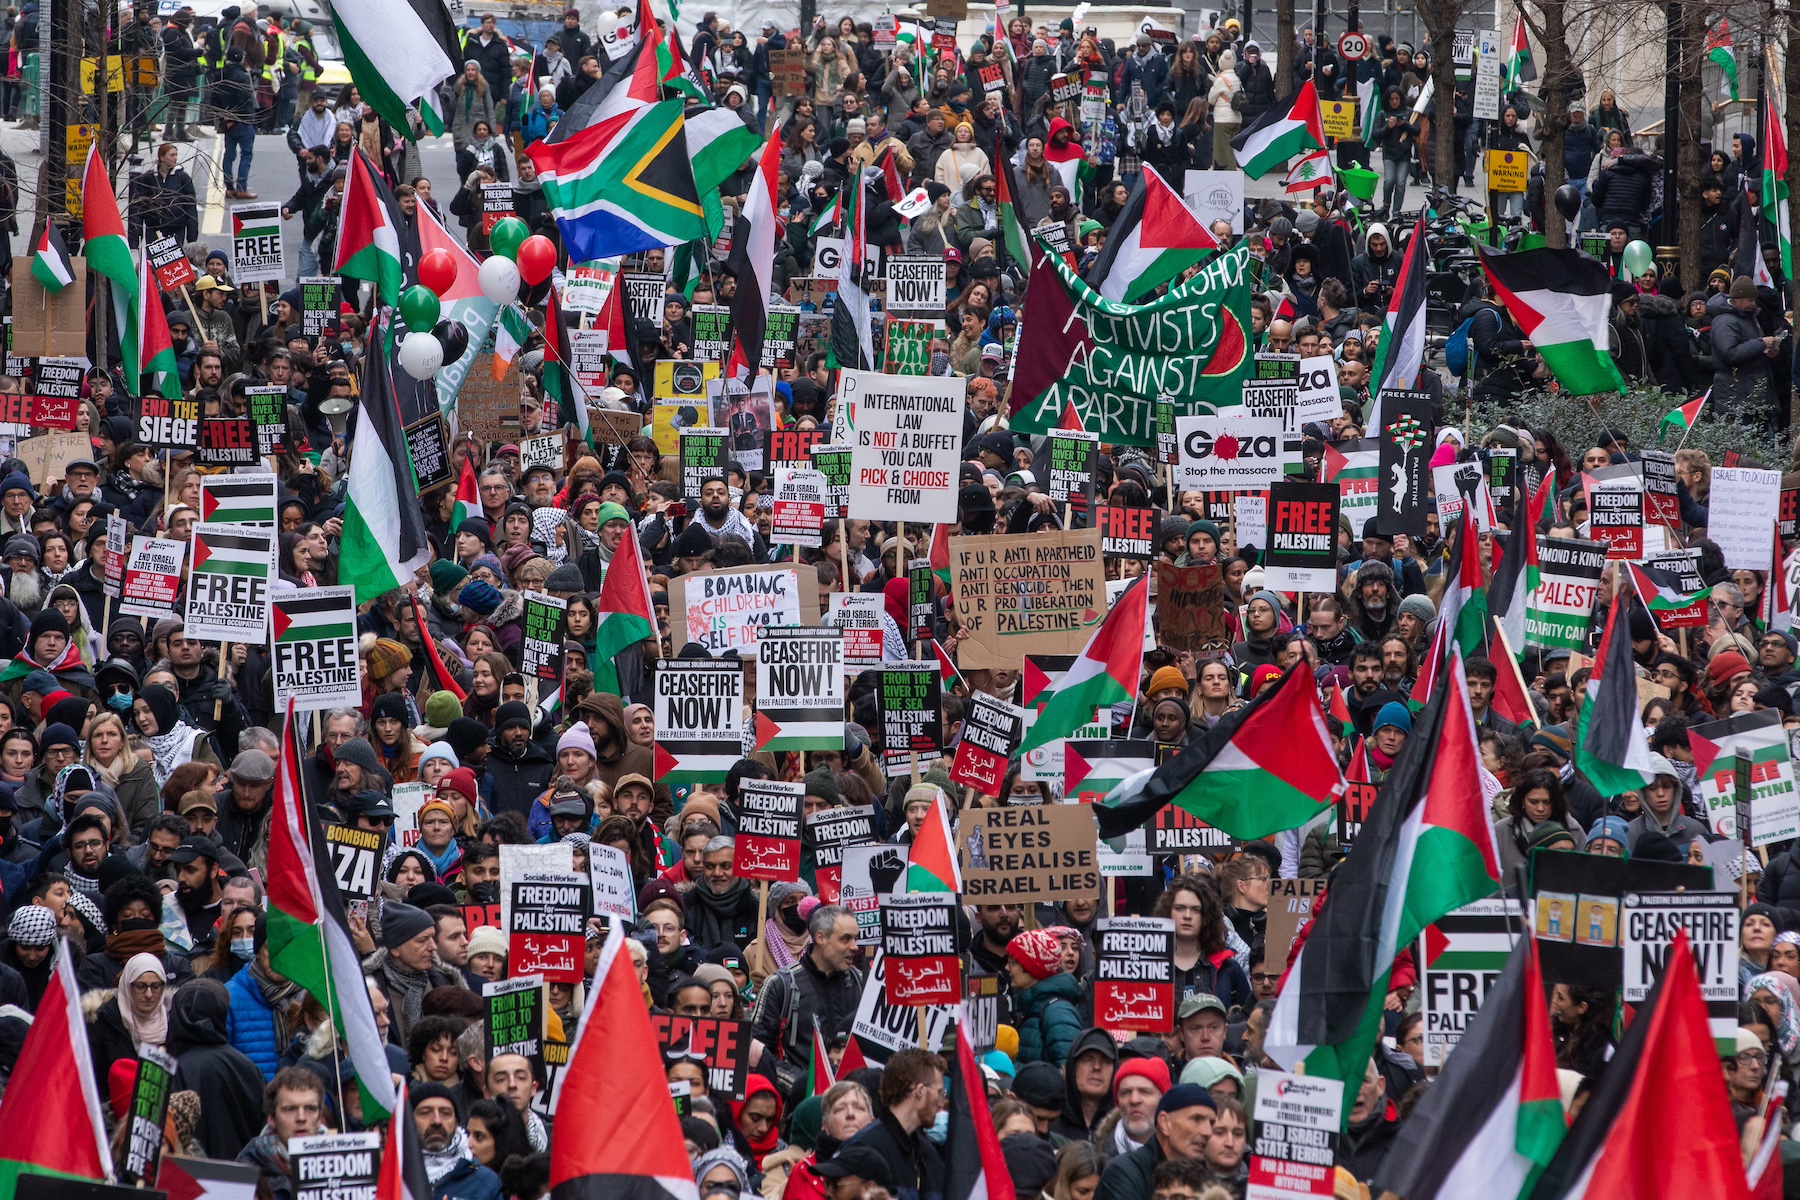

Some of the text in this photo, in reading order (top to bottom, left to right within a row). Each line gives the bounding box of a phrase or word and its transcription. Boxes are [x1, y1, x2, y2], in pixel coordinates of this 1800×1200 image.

[1344, 40, 1363, 52] 20
[978, 64, 1002, 85] FREE
[1051, 74, 1080, 88] END THE
[983, 79, 1006, 91] PALESTINE
[1053, 83, 1082, 101] SIEGE
[1493, 170, 1524, 178] WARNING
[149, 237, 176, 255] FREEDOM
[235, 236, 281, 256] FREE
[154, 250, 184, 267] PALESTINE
[236, 254, 281, 266] PALESTINE
[890, 265, 943, 280] CEASEFIRE
[896, 281, 937, 301] NOW!
[889, 322, 934, 339] CEASE
[1063, 300, 1216, 352] ACTIVISTS
[889, 339, 931, 364] FIRE
[41, 367, 79, 380] FREEDOM
[1064, 341, 1208, 396] AGAINST
[37, 384, 78, 397] PALESTINE
[41, 401, 68, 411] الحرية
[142, 399, 198, 419] END THE
[864, 394, 956, 412] INTERNATIONAL
[36, 412, 70, 422] لفلسطين
[897, 414, 922, 429] LAW
[139, 419, 197, 444] SIEGE
[202, 421, 251, 448] FREE
[530, 437, 553, 450] FREE
[860, 432, 956, 449] IS NOT A BUFFET
[1185, 431, 1276, 458] Gza
[201, 448, 253, 462] PALESTINE
[522, 447, 563, 461] PALESTINE
[881, 451, 931, 467] YOU CAN
[861, 469, 949, 487] PICK & CHOOSE
[1185, 467, 1207, 477] Stop
[1229, 467, 1277, 475] massacre
[1713, 469, 1737, 481] ISRAEL
[1740, 470, 1750, 482] TO
[1751, 472, 1762, 483] DO
[888, 489, 920, 504] FROM
[1596, 495, 1638, 506] FREEDOM
[1096, 506, 1152, 539] FREE
[1276, 501, 1331, 532] FREE
[1593, 512, 1640, 525] PALESTINE
[220, 527, 242, 535] Solidarity
[1274, 535, 1330, 550] PALESTINE
[151, 554, 174, 564] ISRAELI
[960, 546, 1095, 565] IF U R ANTI APARTHEID
[134, 561, 176, 573] STATE TERROR
[960, 565, 1070, 581] ANTI OCCUPATION
[192, 574, 266, 605] FREE
[705, 575, 785, 597] BOMBING
[961, 579, 1094, 596] ANTI GENOCIDE, THEN
[189, 603, 264, 619] PALESTINE
[701, 594, 776, 615] CHILDREN
[960, 594, 1093, 613] U R PRO LIBERATION
[203, 617, 225, 625] ISRAELI
[227, 619, 263, 628] OCCUPATION
[713, 612, 783, 628] IS NOT
[966, 613, 1080, 631] OF PALESTINE
[700, 628, 736, 649] SELF
[275, 639, 355, 672] FREE
[761, 641, 840, 664] CEASEFIRE
[277, 668, 356, 687] PALESTINE
[659, 674, 739, 696] CEASEFIRE
[770, 665, 833, 696] NOW!
[883, 672, 931, 684] FROM THE
[884, 685, 927, 697] RIVER TO
[884, 698, 923, 709] THE SEA
[668, 698, 731, 729] NOW!
[885, 710, 935, 723] PALESTINE
[972, 703, 1013, 732] FREEDOM
[885, 724, 923, 735] WILL BE
[886, 736, 909, 748] FREE
[965, 726, 1010, 755] PALESTINE
[966, 750, 995, 768] الحرية
[959, 766, 995, 784] لفلسطين
[748, 782, 795, 792] Socialist Worker
[744, 793, 796, 812] FREEDOM
[740, 817, 798, 837] PALESTINE
[988, 811, 1050, 827] REAL
[327, 825, 379, 848] BOMBING
[989, 832, 1050, 849] EYES
[746, 840, 785, 855] الحرية
[741, 856, 790, 871] لفلسطين
[990, 851, 1091, 871] REALISE
[963, 873, 1097, 895] ISRAEL LIES
[519, 887, 580, 905] FREEDOM
[514, 912, 582, 932] PALESTINE
[887, 909, 948, 928] FREEDOM
[1108, 921, 1163, 929] Socialist Worker
[524, 939, 569, 954] الحرية
[886, 935, 954, 955] PALESTINE
[1103, 934, 1166, 953] FREEDOM
[518, 956, 574, 972] لفلسطين
[1100, 960, 1169, 980] PALESTINE
[1110, 987, 1156, 1001] الحرية
[1105, 1004, 1163, 1021] لفلسطين
[1263, 1127, 1329, 1145] END ISRAELI
[1257, 1142, 1333, 1166] STATE TERROR
[299, 1154, 371, 1179] FREEDOM
